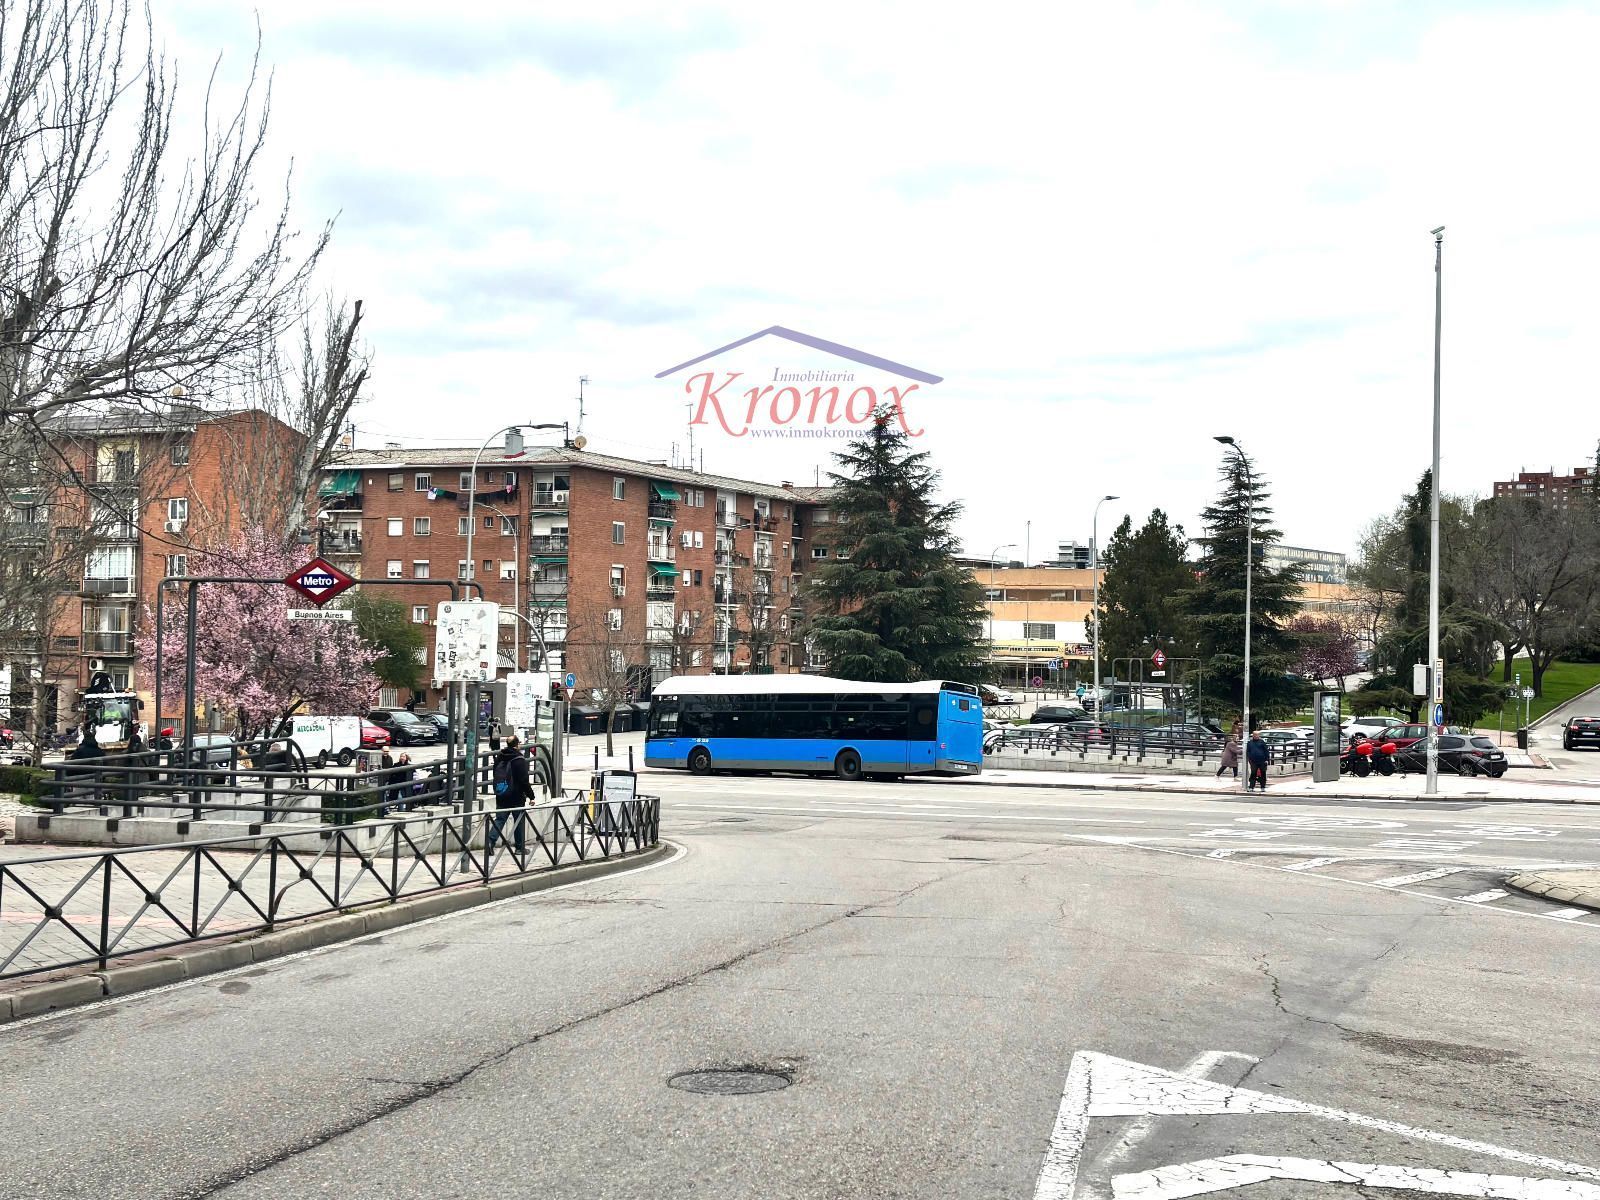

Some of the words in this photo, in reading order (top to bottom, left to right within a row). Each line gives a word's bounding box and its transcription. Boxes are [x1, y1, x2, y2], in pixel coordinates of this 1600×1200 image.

[303, 576, 333, 586] Metro
[294, 611, 323, 619] Buenos
[324, 611, 344, 619] Aires
